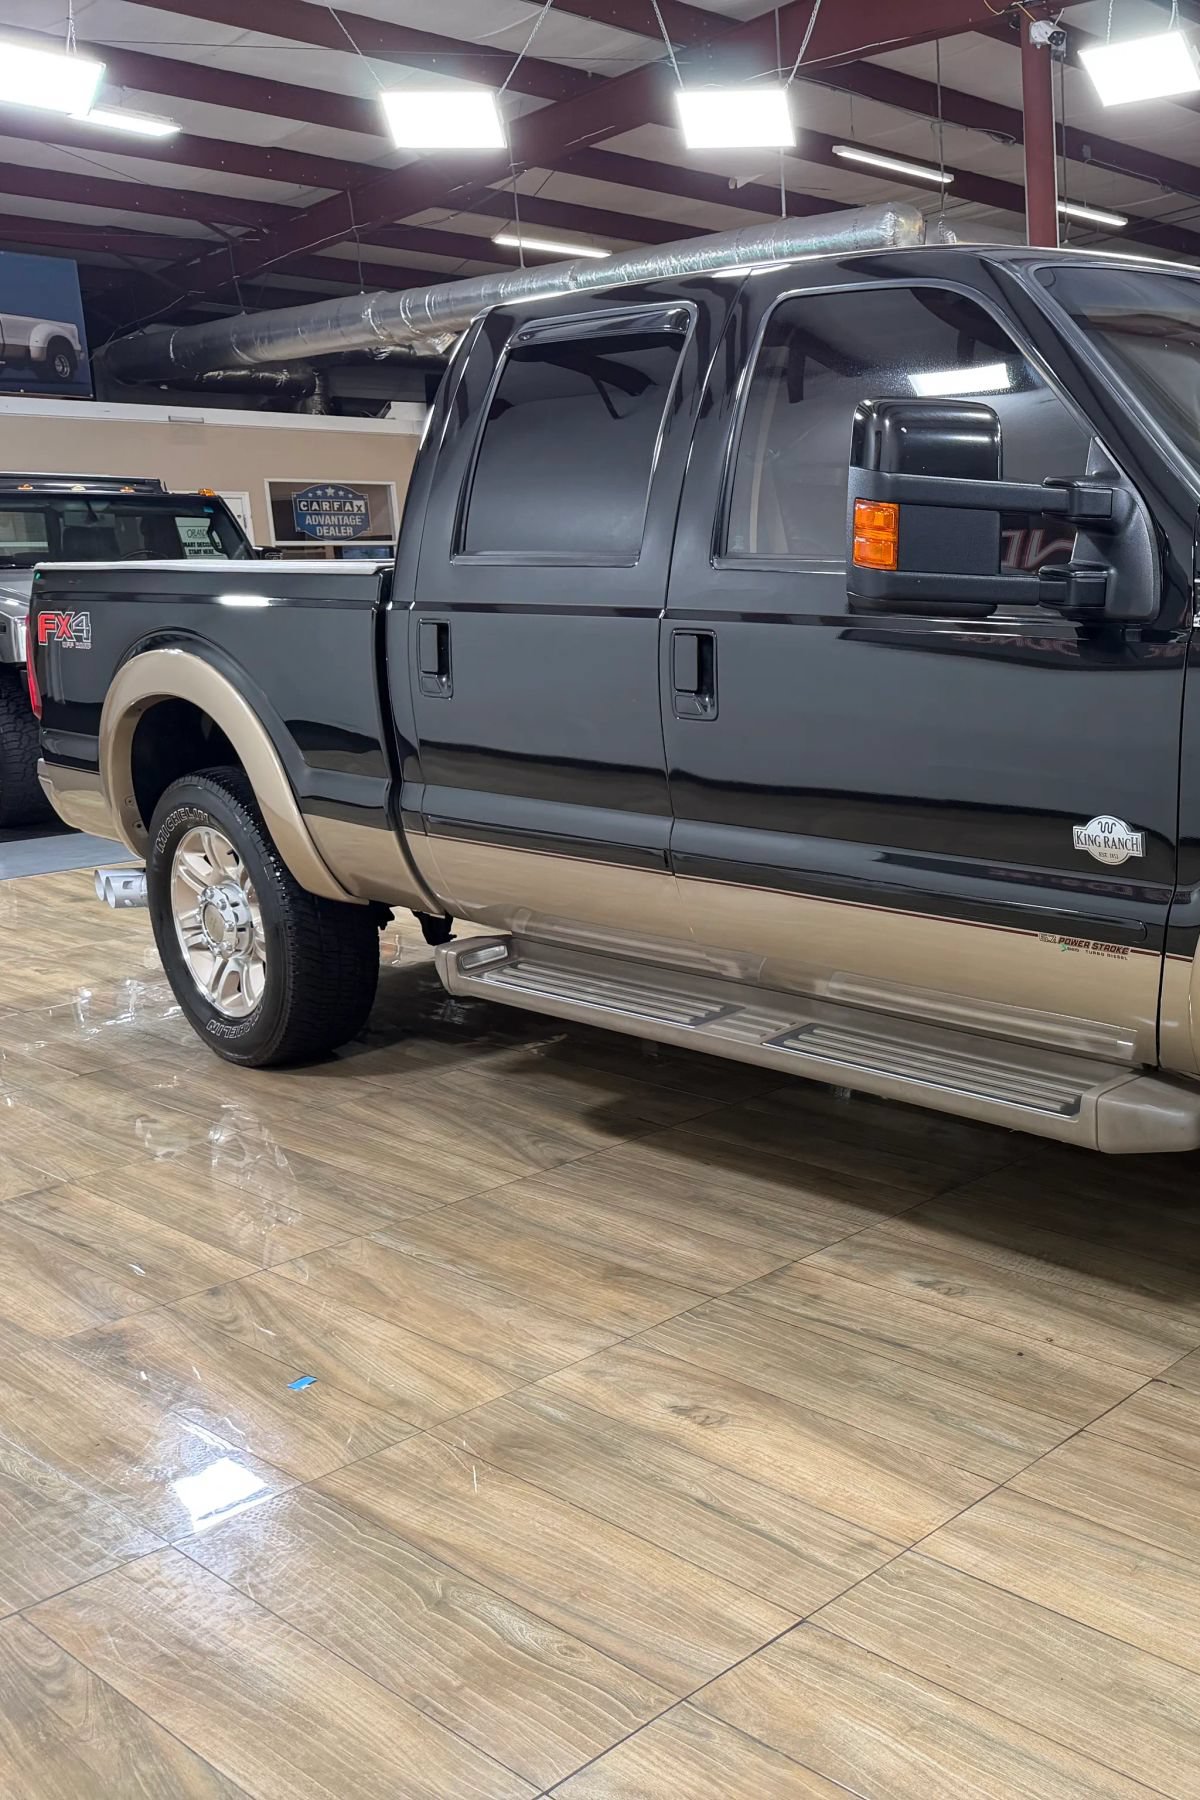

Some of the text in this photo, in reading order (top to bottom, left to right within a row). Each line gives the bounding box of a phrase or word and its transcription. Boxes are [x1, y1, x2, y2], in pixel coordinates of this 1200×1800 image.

[299, 500, 364, 513] CARFAX
[316, 526, 353, 536] DEALER
[38, 611, 91, 645] FX4
[155, 807, 210, 853] MICHELIN
[1076, 831, 1139, 852] KING RANCH
[1058, 936, 1090, 949] POWER
[1091, 943, 1130, 955] STROKE
